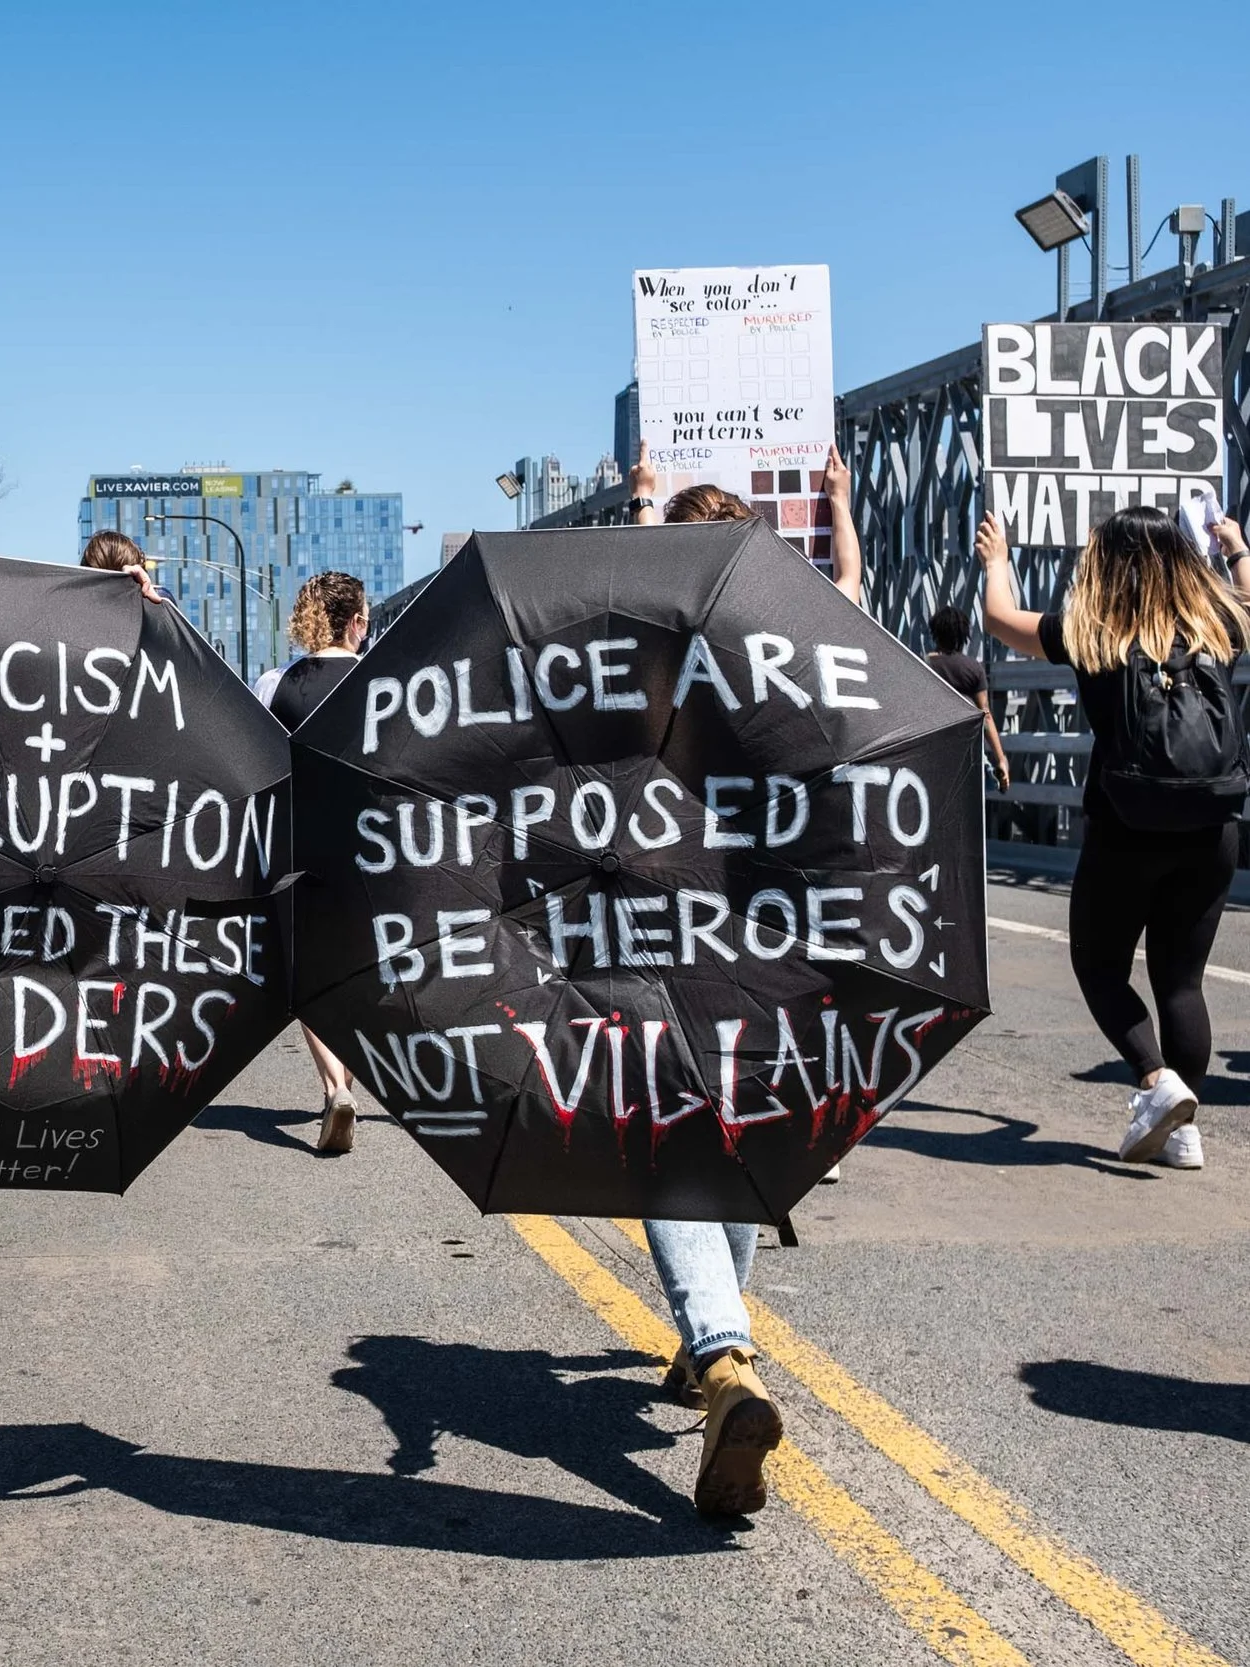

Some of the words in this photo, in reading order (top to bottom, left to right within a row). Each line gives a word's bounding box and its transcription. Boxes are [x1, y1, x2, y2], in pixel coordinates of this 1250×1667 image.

[638, 276, 685, 297] When
[703, 283, 732, 298] you
[747, 273, 797, 294] don't
[650, 317, 710, 330] RESPECTED
[743, 312, 812, 327] MURDERED
[750, 325, 761, 334] BY
[769, 324, 797, 333] POLICE
[652, 330, 662, 338] BY
[671, 328, 701, 337] POLICE
[987, 324, 1217, 396] BLACK
[673, 410, 705, 425] you
[716, 404, 761, 422] can't
[773, 405, 804, 421] see
[672, 424, 765, 444] patterns
[989, 398, 1218, 472] LIVES
[649, 447, 713, 465] RESPECTED
[749, 443, 824, 459] MURDERED
[778, 455, 809, 466] POLICE
[673, 460, 703, 471] POLICE
[362, 636, 649, 754] POLICE
[673, 633, 884, 712] ARE
[24, 722, 67, 763] +
[354, 774, 810, 874] SUPPOSED
[831, 765, 931, 847] TO
[96, 901, 268, 985] THESE
[372, 908, 496, 985] BE
[545, 884, 930, 970] HEROES
[355, 1023, 501, 1104] NOT
[16, 1121, 101, 1150] Lives
